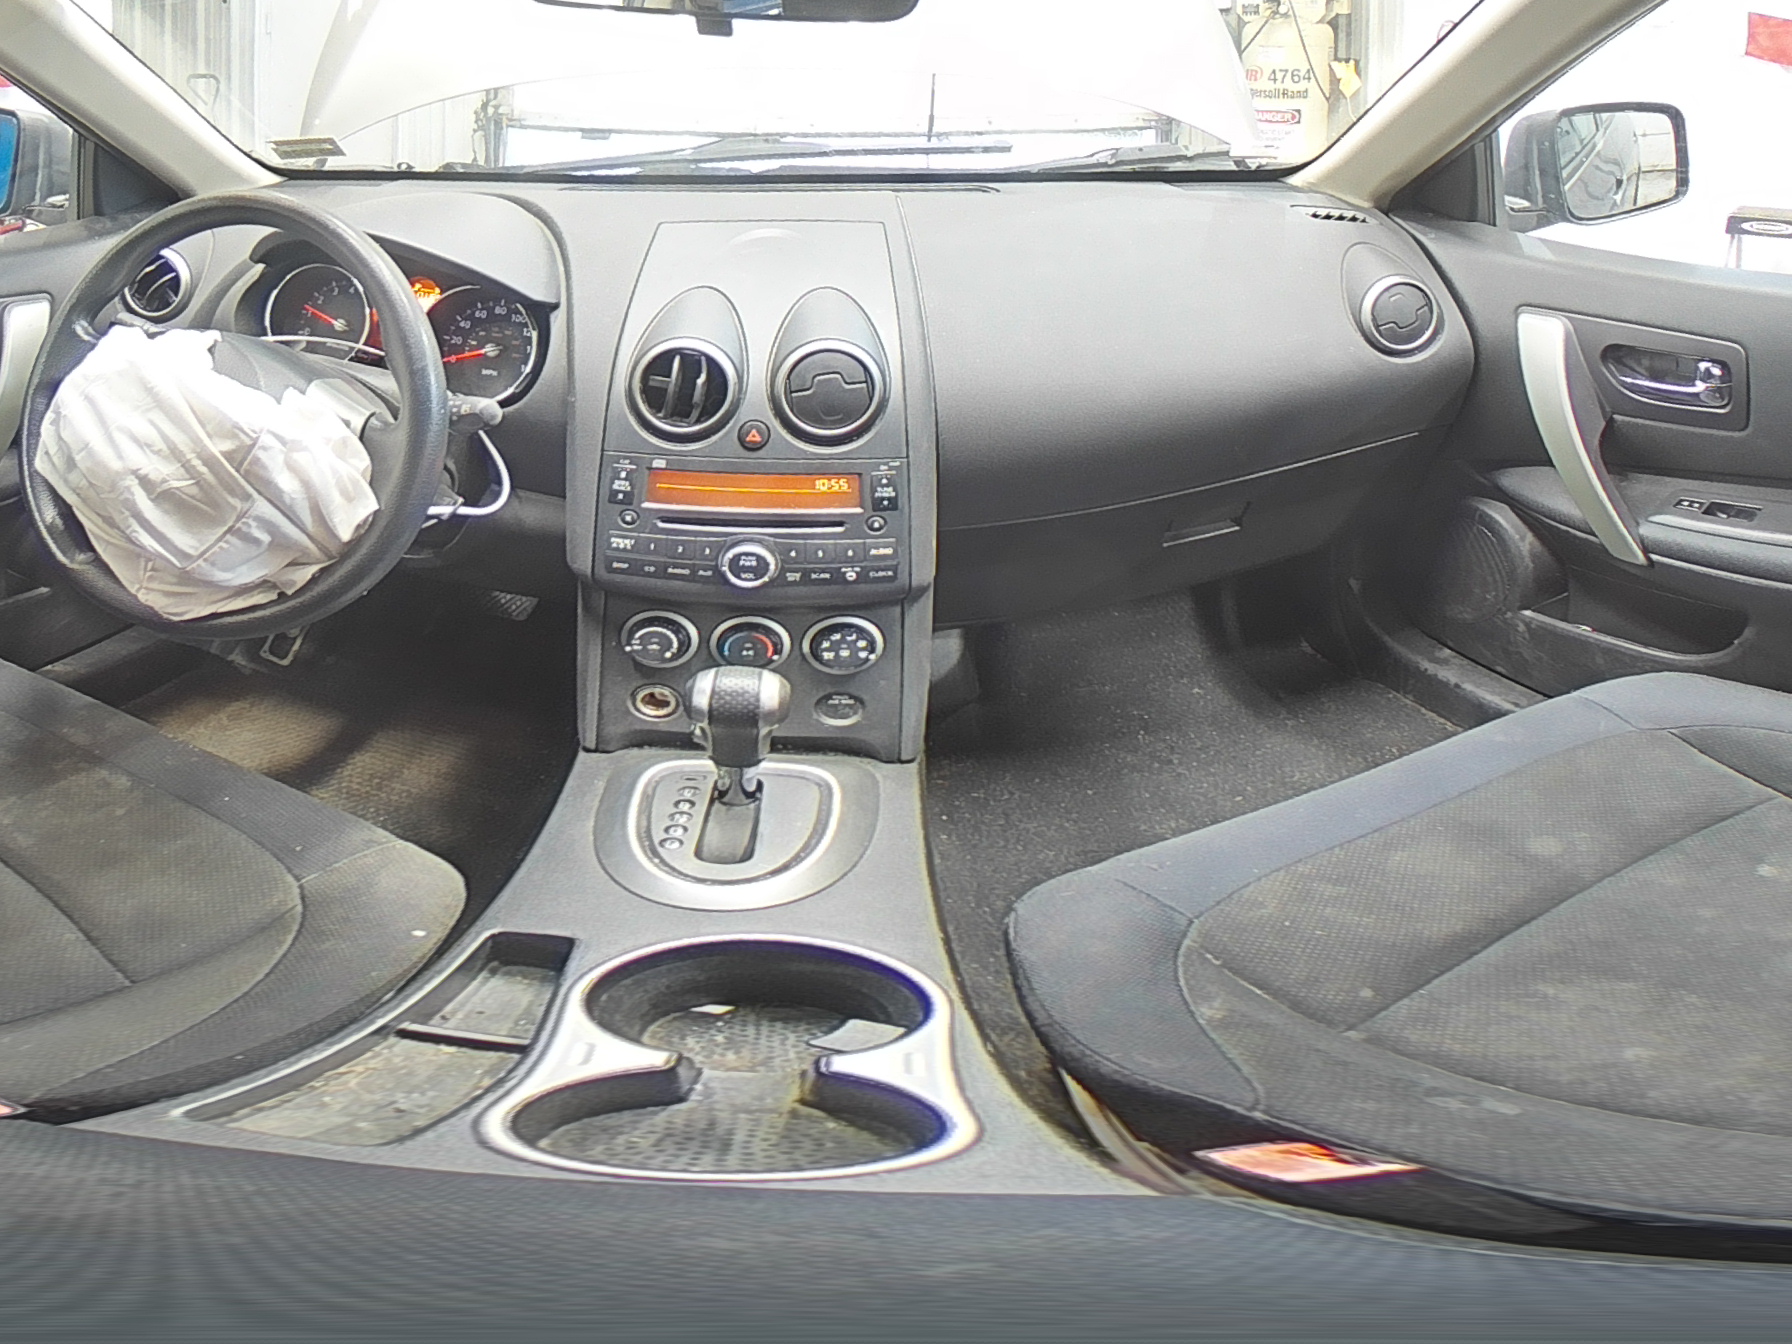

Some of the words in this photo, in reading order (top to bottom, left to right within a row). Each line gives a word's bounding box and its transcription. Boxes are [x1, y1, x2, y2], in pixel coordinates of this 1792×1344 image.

[1267, 68, 1312, 85] 4764
[1256, 112, 1292, 121] ANGER
[474, 310, 487, 319] 60
[494, 306, 507, 315] 80
[511, 314, 527, 323] 100
[459, 320, 471, 329] 40
[450, 336, 463, 344] 20
[481, 368, 498, 376] MPH
[814, 478, 849, 491] 10:55
